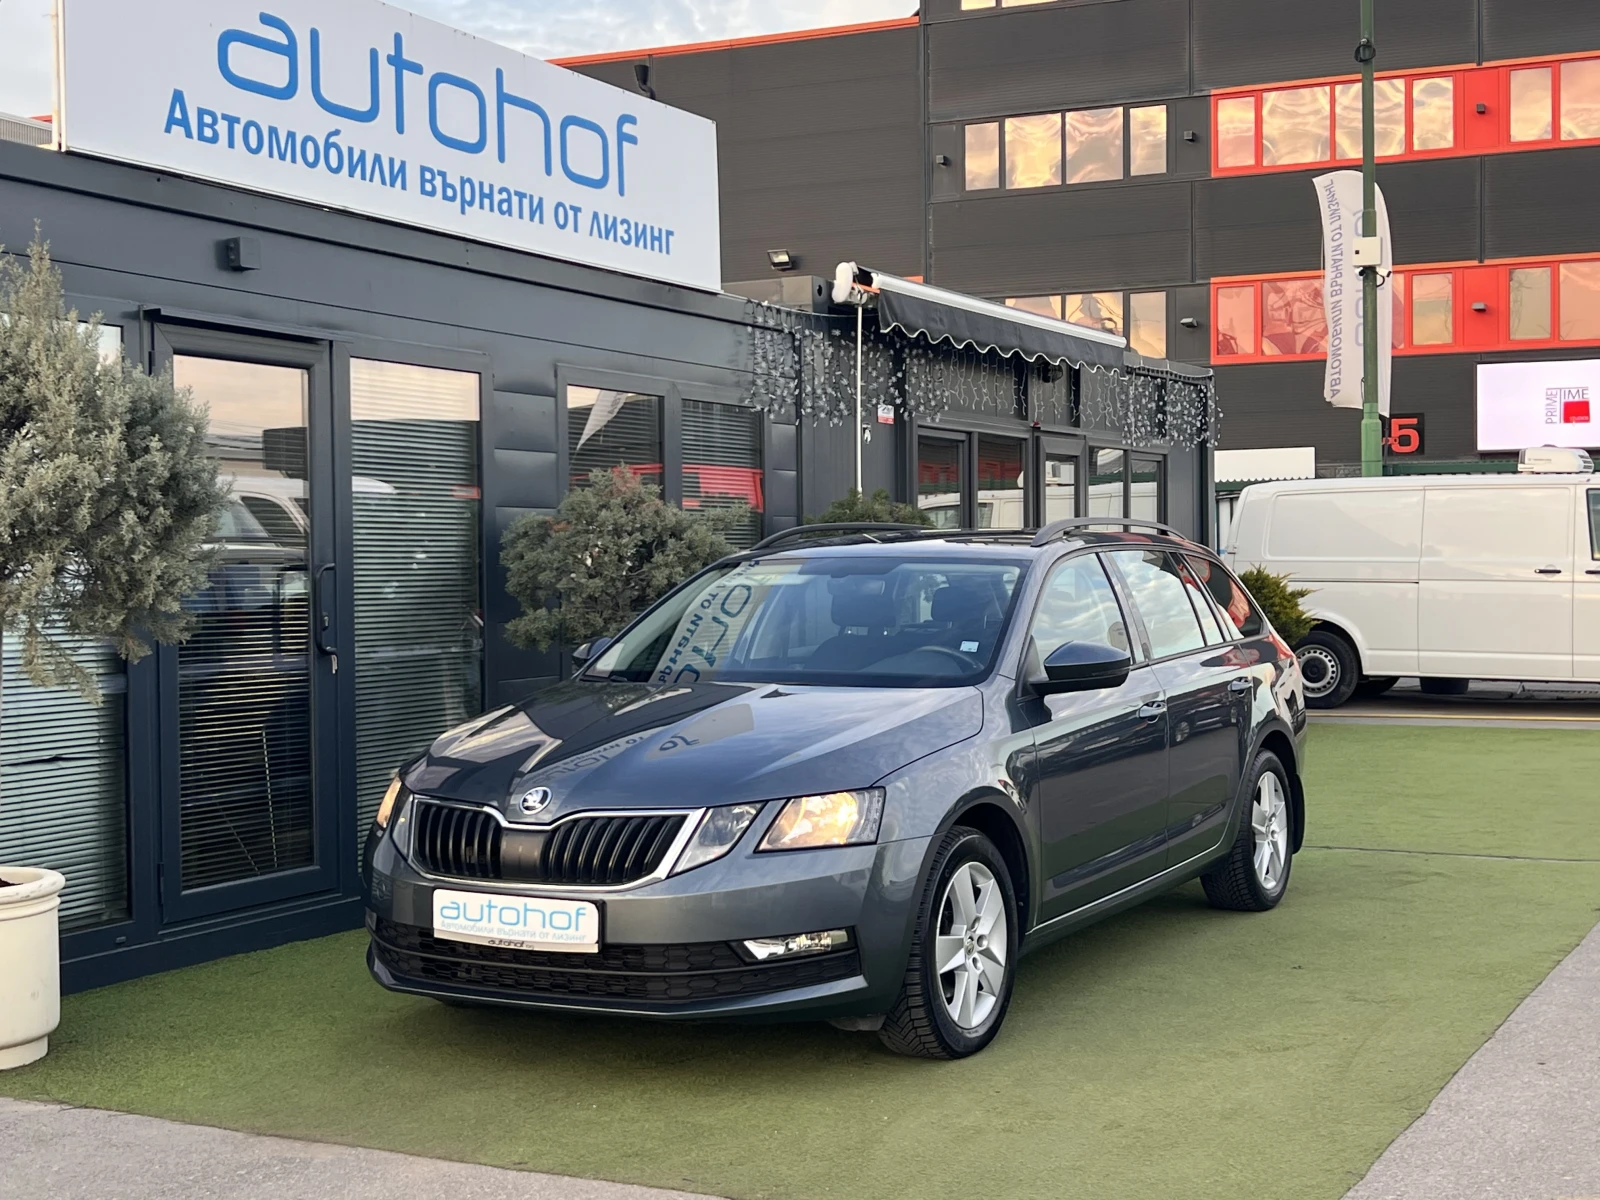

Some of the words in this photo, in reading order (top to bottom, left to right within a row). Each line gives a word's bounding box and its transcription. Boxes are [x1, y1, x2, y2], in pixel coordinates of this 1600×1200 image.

[216, 12, 638, 197] autohof
[164, 88, 407, 191] Автомобили
[419, 164, 544, 225] върнати
[554, 201, 582, 233] от
[589, 211, 674, 255] лизинг
[1545, 389, 1558, 424] PRIME
[1391, 418, 1420, 453] 5
[440, 899, 587, 931] autohof
[441, 920, 494, 934] Автомобили
